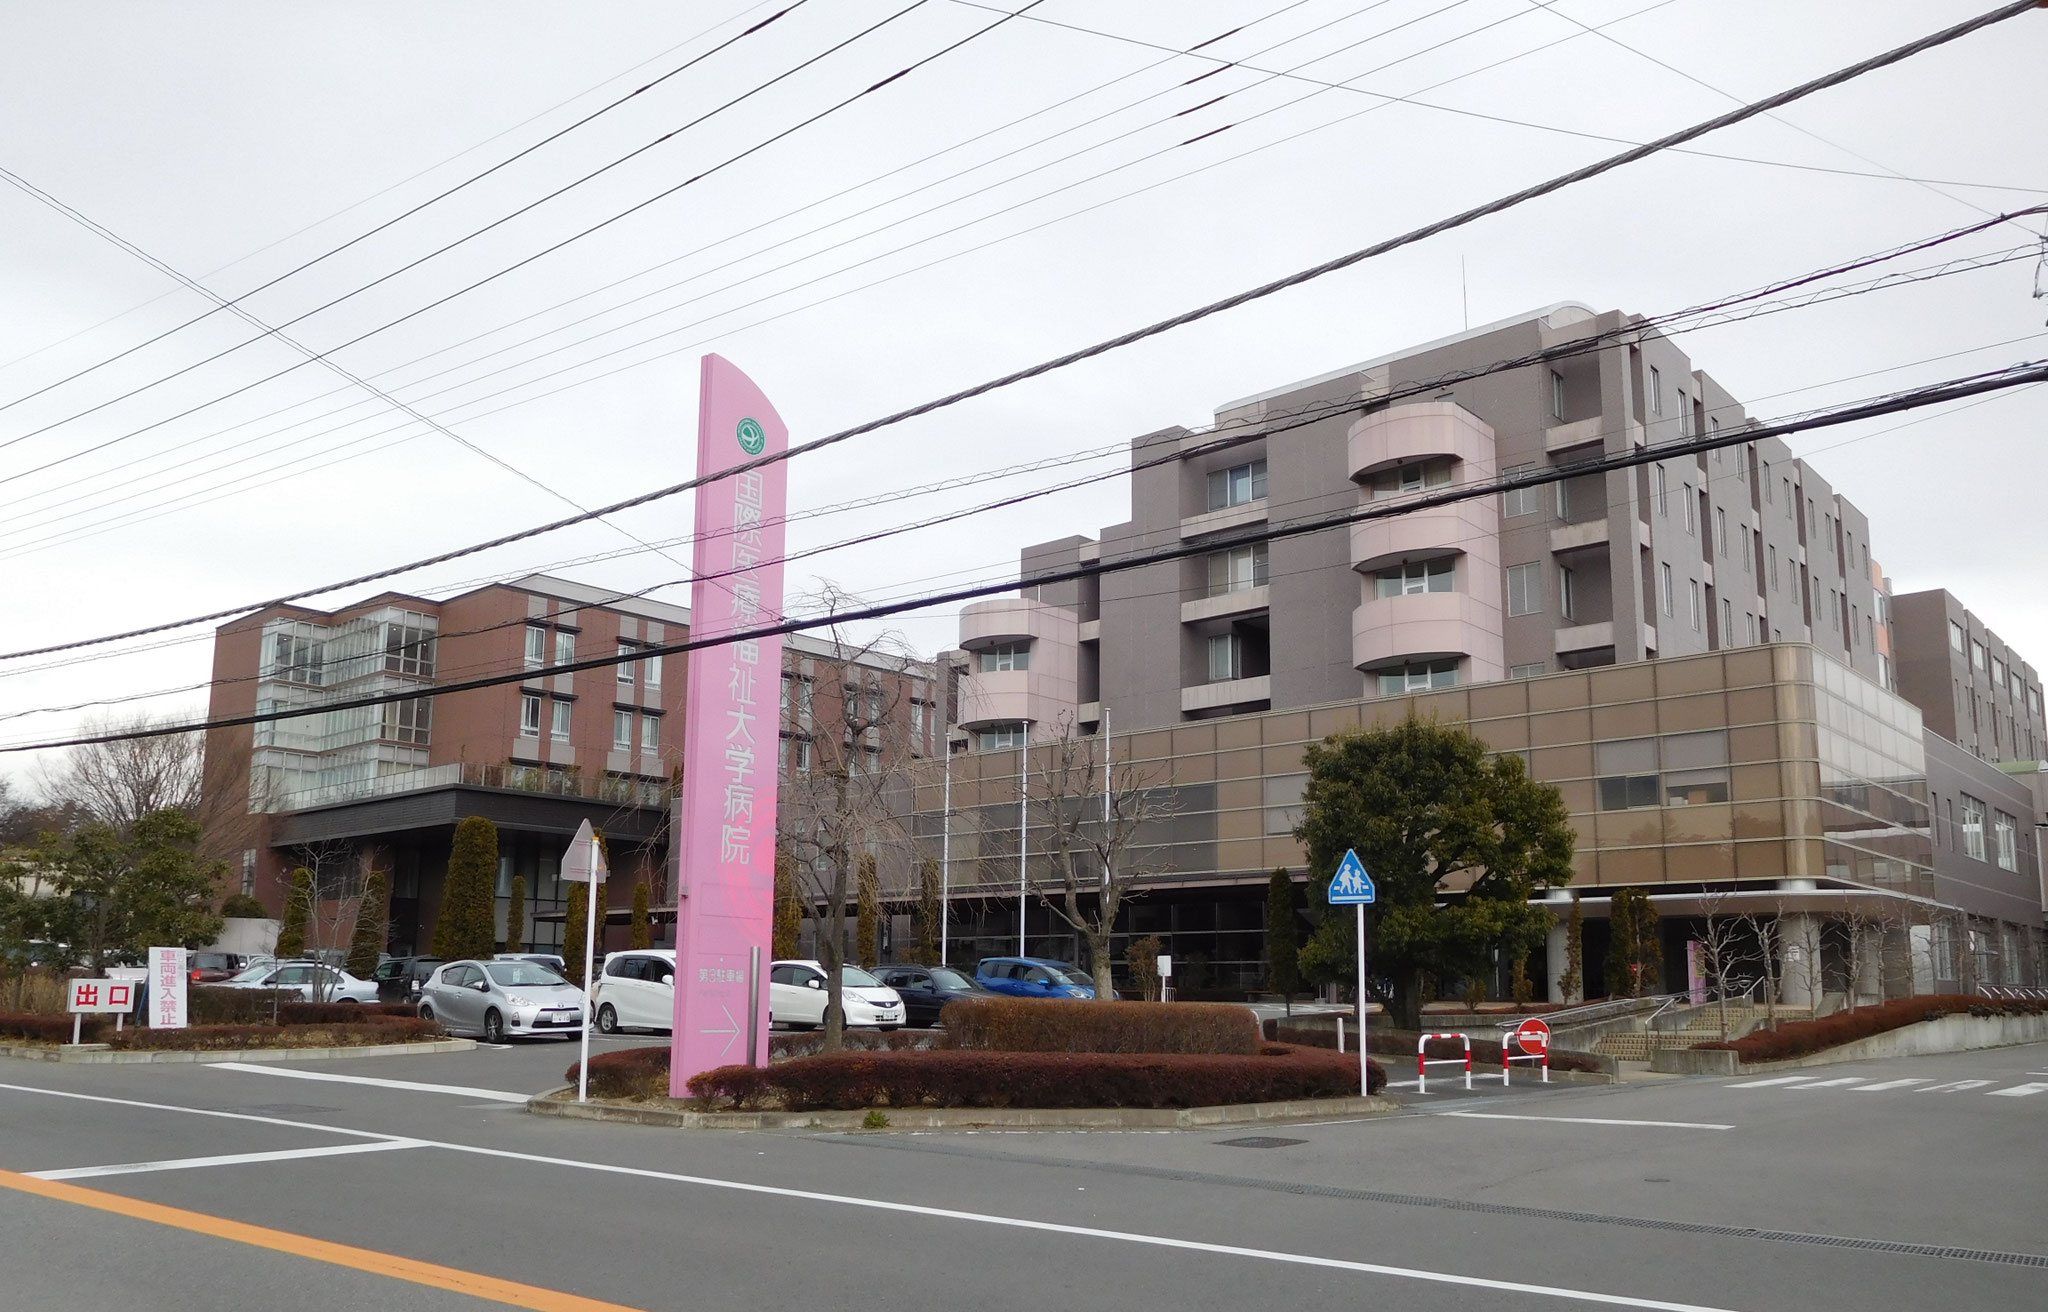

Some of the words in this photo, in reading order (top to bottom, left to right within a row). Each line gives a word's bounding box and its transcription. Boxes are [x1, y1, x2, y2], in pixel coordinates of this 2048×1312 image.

[720, 467, 763, 865] 国際医療福祉大学病院
[76, 984, 129, 1006] 出口
[160, 949, 177, 1025] 車両進入禁止
